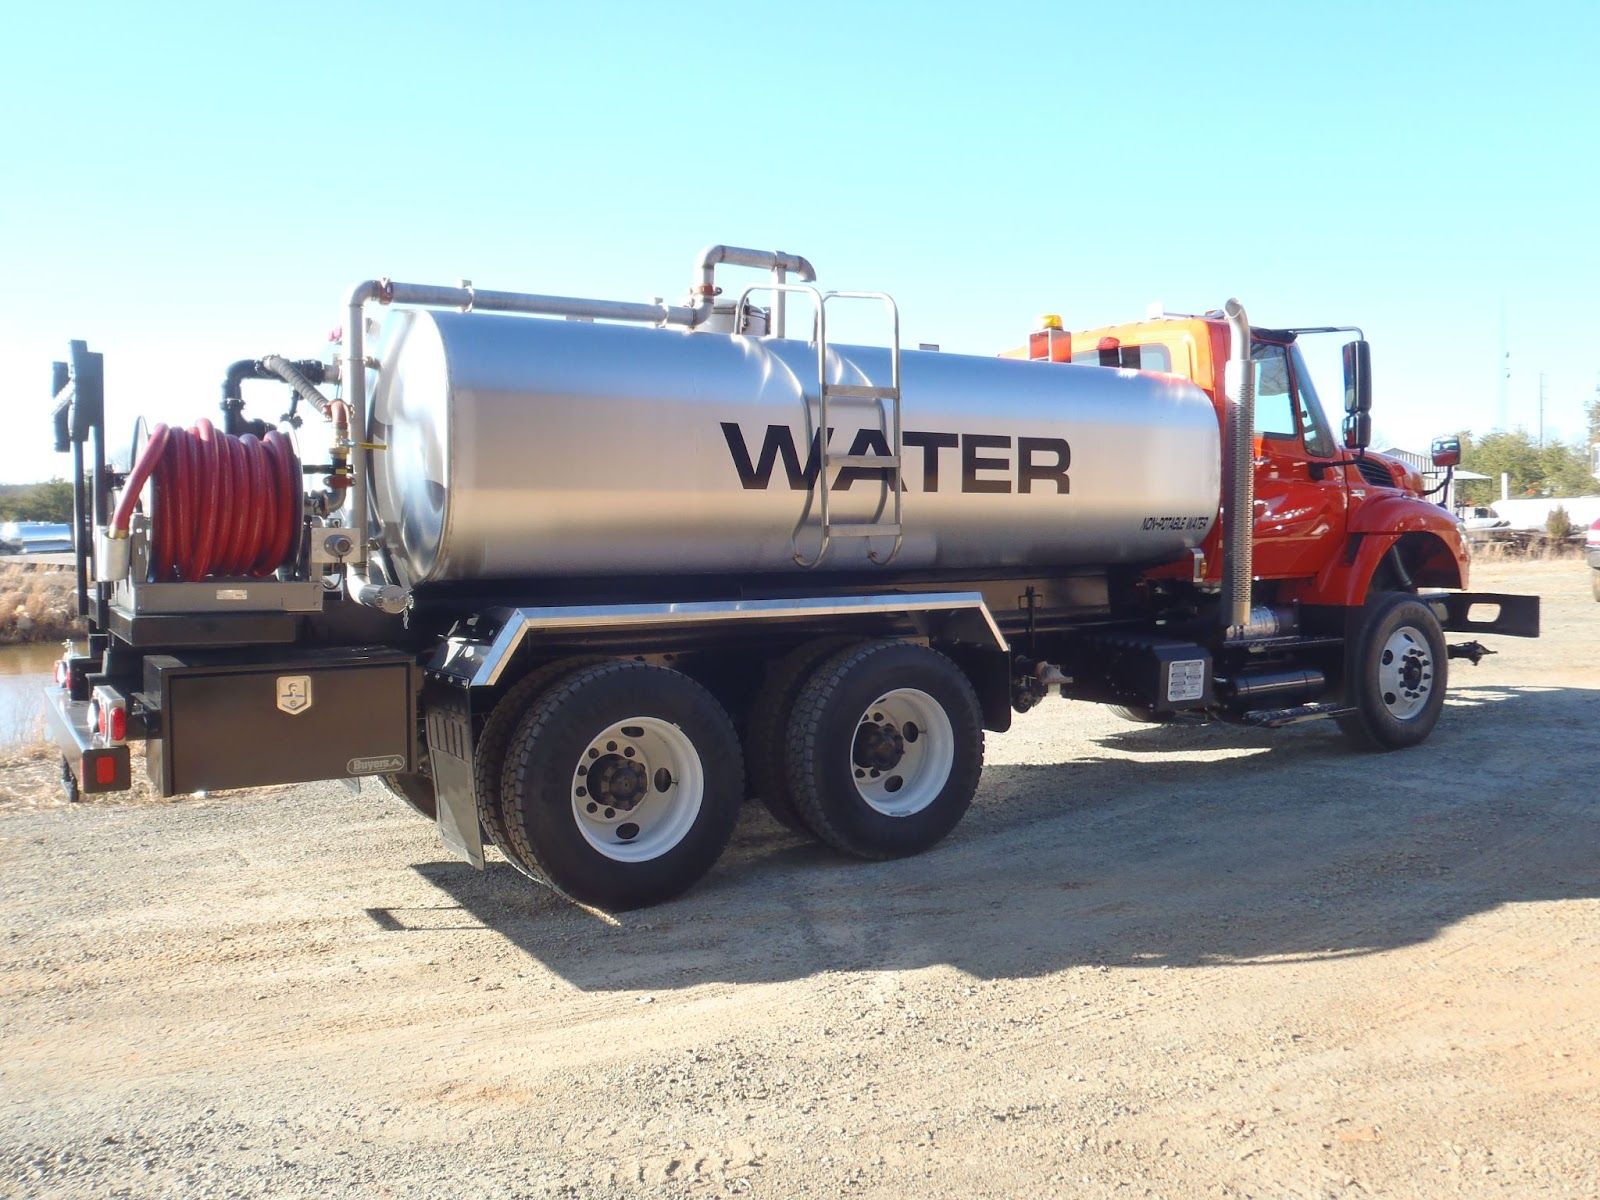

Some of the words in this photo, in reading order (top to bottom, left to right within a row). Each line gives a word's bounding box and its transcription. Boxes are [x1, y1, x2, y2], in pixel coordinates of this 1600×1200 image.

[720, 421, 1072, 495] WATER
[1142, 516, 1187, 530] NON-POTABLE
[1186, 516, 1209, 530] WATER
[353, 759, 390, 771] Buyers
